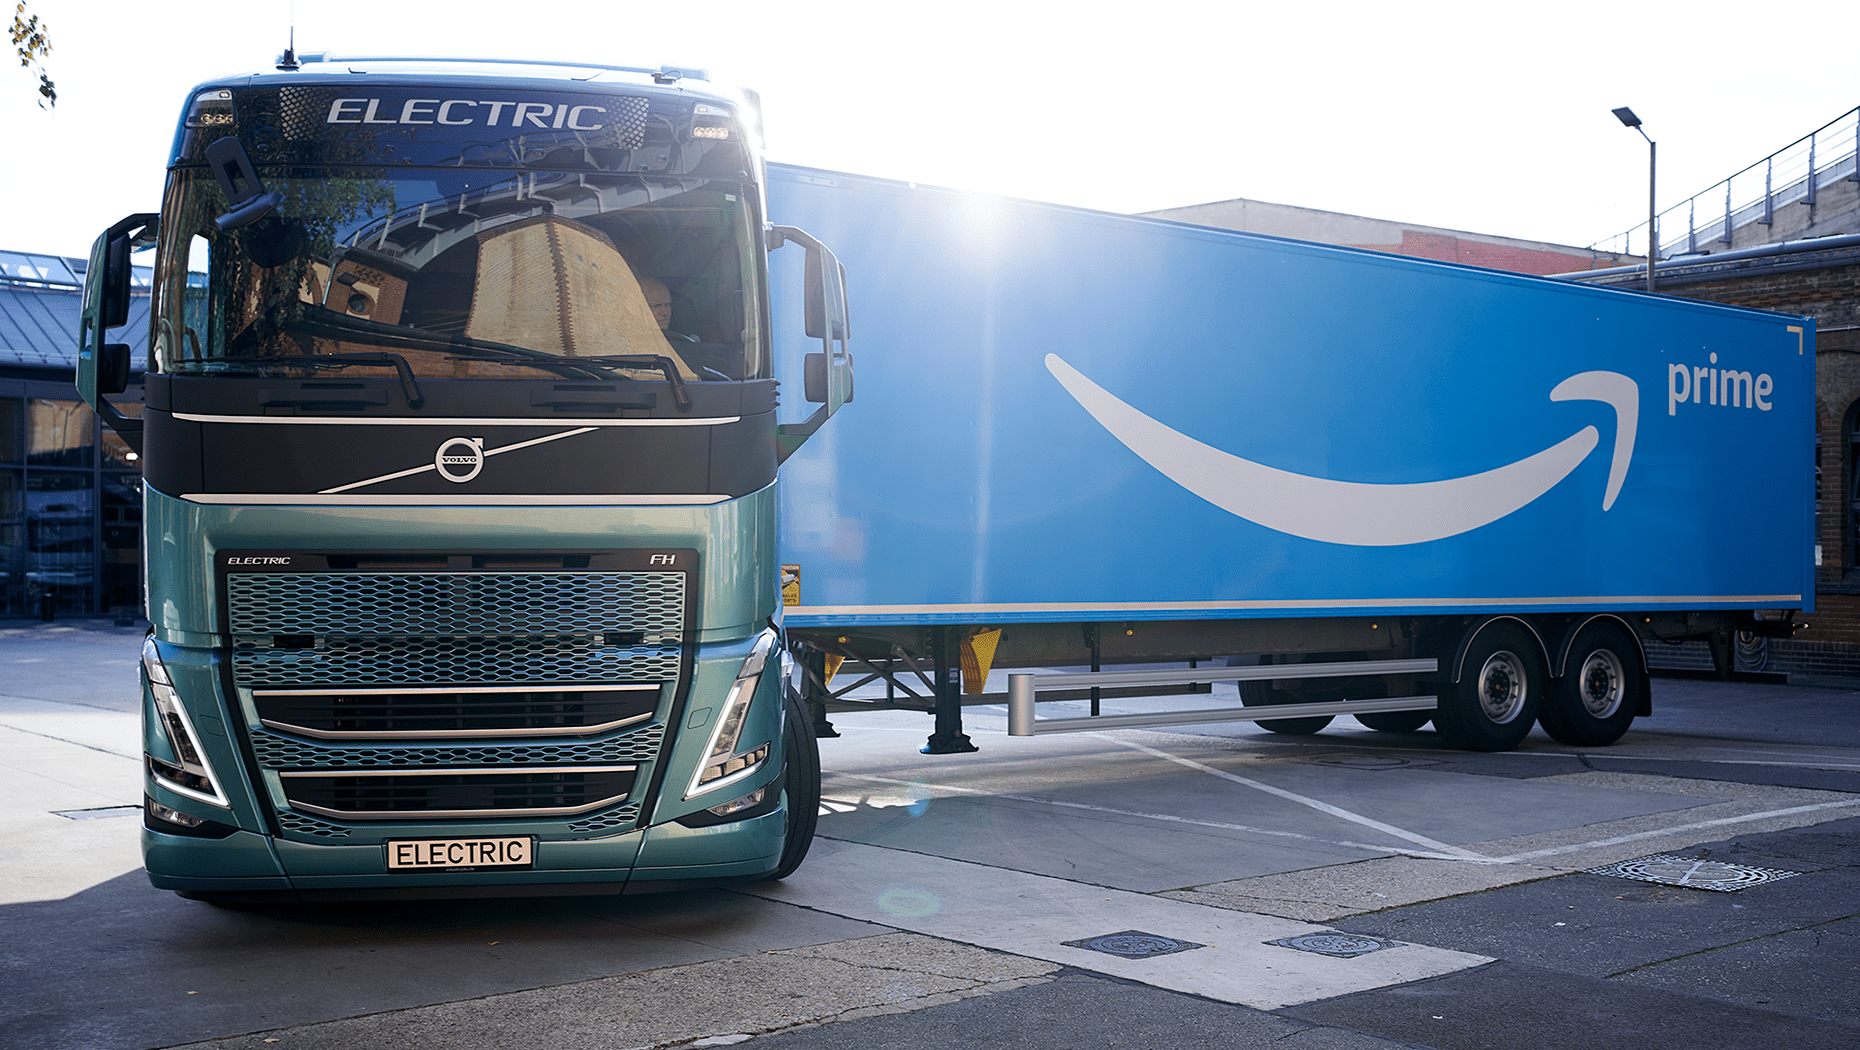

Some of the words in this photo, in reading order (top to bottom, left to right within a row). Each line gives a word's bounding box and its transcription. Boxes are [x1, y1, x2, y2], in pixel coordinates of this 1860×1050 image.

[326, 98, 607, 131] ELECTRIC
[1668, 352, 1773, 416] prime
[227, 556, 291, 565] ELECTRIC
[650, 554, 676, 565] FH
[397, 841, 523, 865] ELECTRIC
